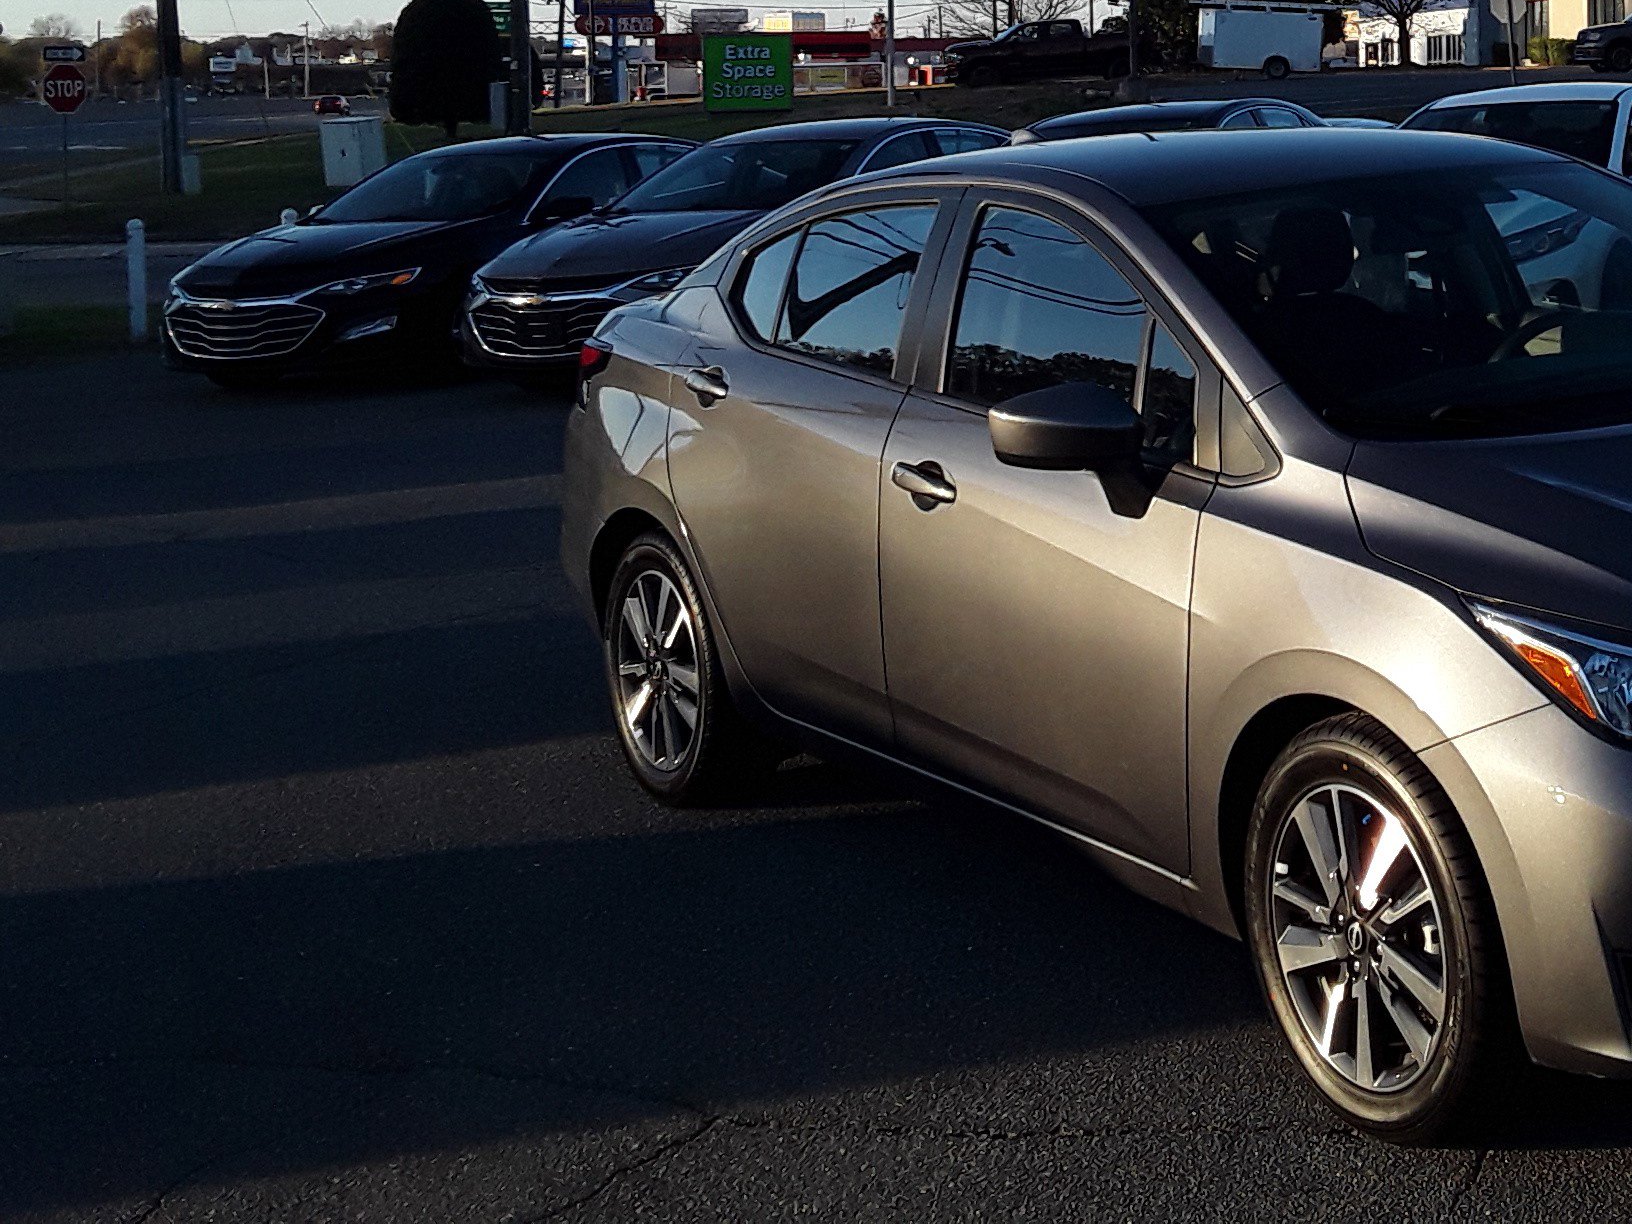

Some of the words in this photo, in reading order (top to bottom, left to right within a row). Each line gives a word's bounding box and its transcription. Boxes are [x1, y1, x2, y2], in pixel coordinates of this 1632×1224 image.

[725, 44, 771, 60] Extra
[721, 62, 776, 81] Space
[45, 80, 84, 97] STOP
[712, 81, 785, 100] Storage
